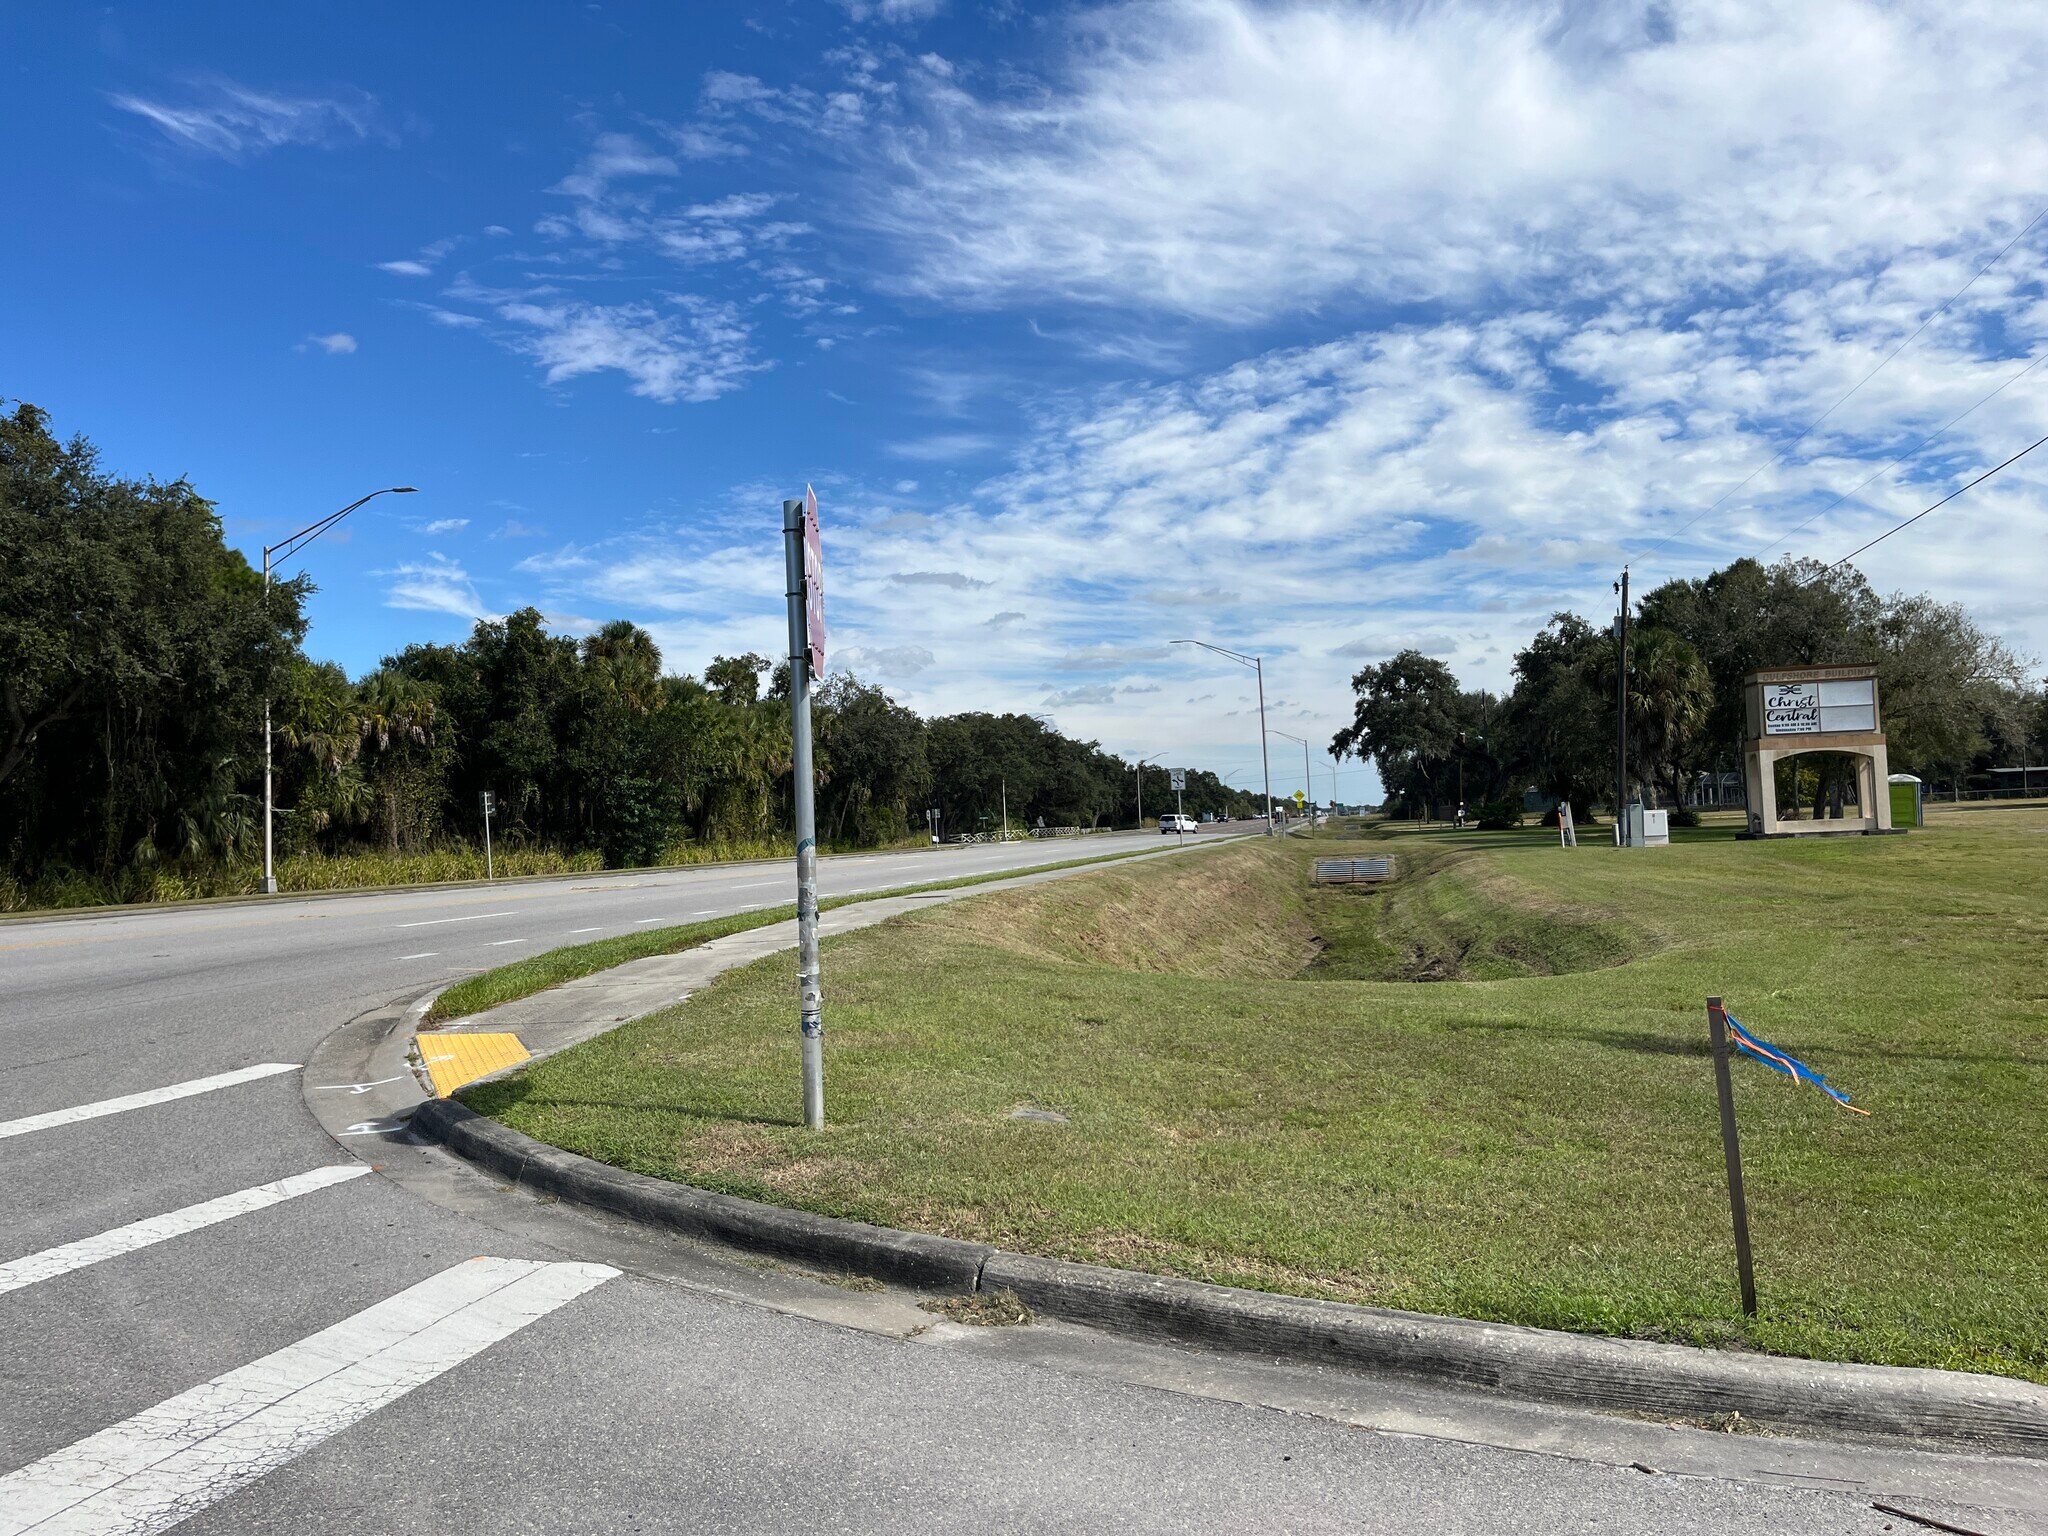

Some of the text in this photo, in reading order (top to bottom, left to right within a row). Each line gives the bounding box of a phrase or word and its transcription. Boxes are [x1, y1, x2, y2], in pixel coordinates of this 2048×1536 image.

[1824, 667, 1872, 678] BUILDING
[1768, 695, 1816, 708] Christ
[1766, 708, 1818, 721] Central
